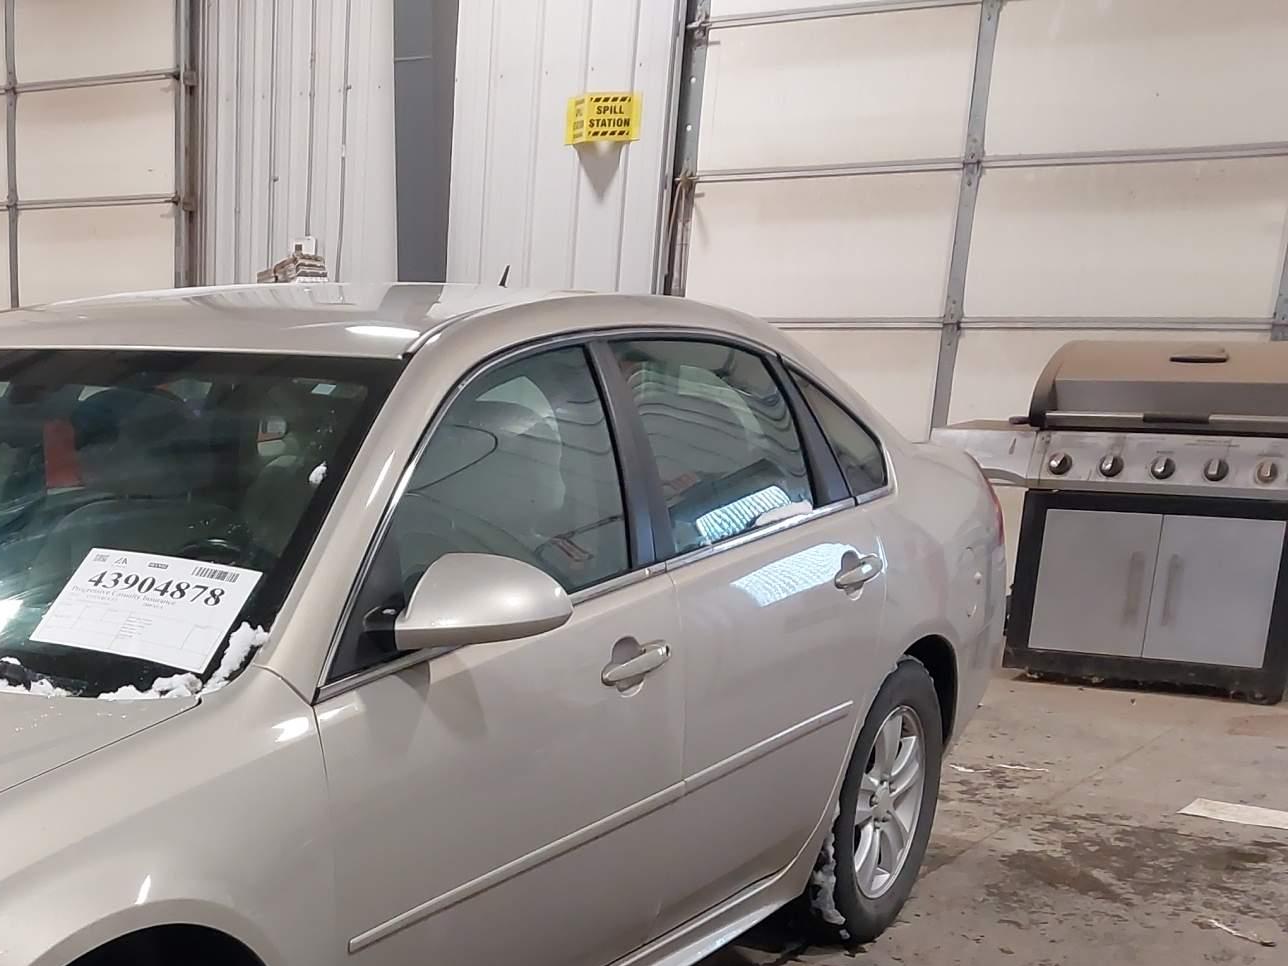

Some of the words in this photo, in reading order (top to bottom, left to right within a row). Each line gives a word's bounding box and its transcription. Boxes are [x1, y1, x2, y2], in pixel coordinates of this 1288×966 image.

[596, 105, 624, 115] SPILL
[588, 118, 630, 128] STATION
[72, 585, 111, 596] Progressive
[142, 595, 177, 606] Insurance
[88, 570, 225, 606] 43904878
